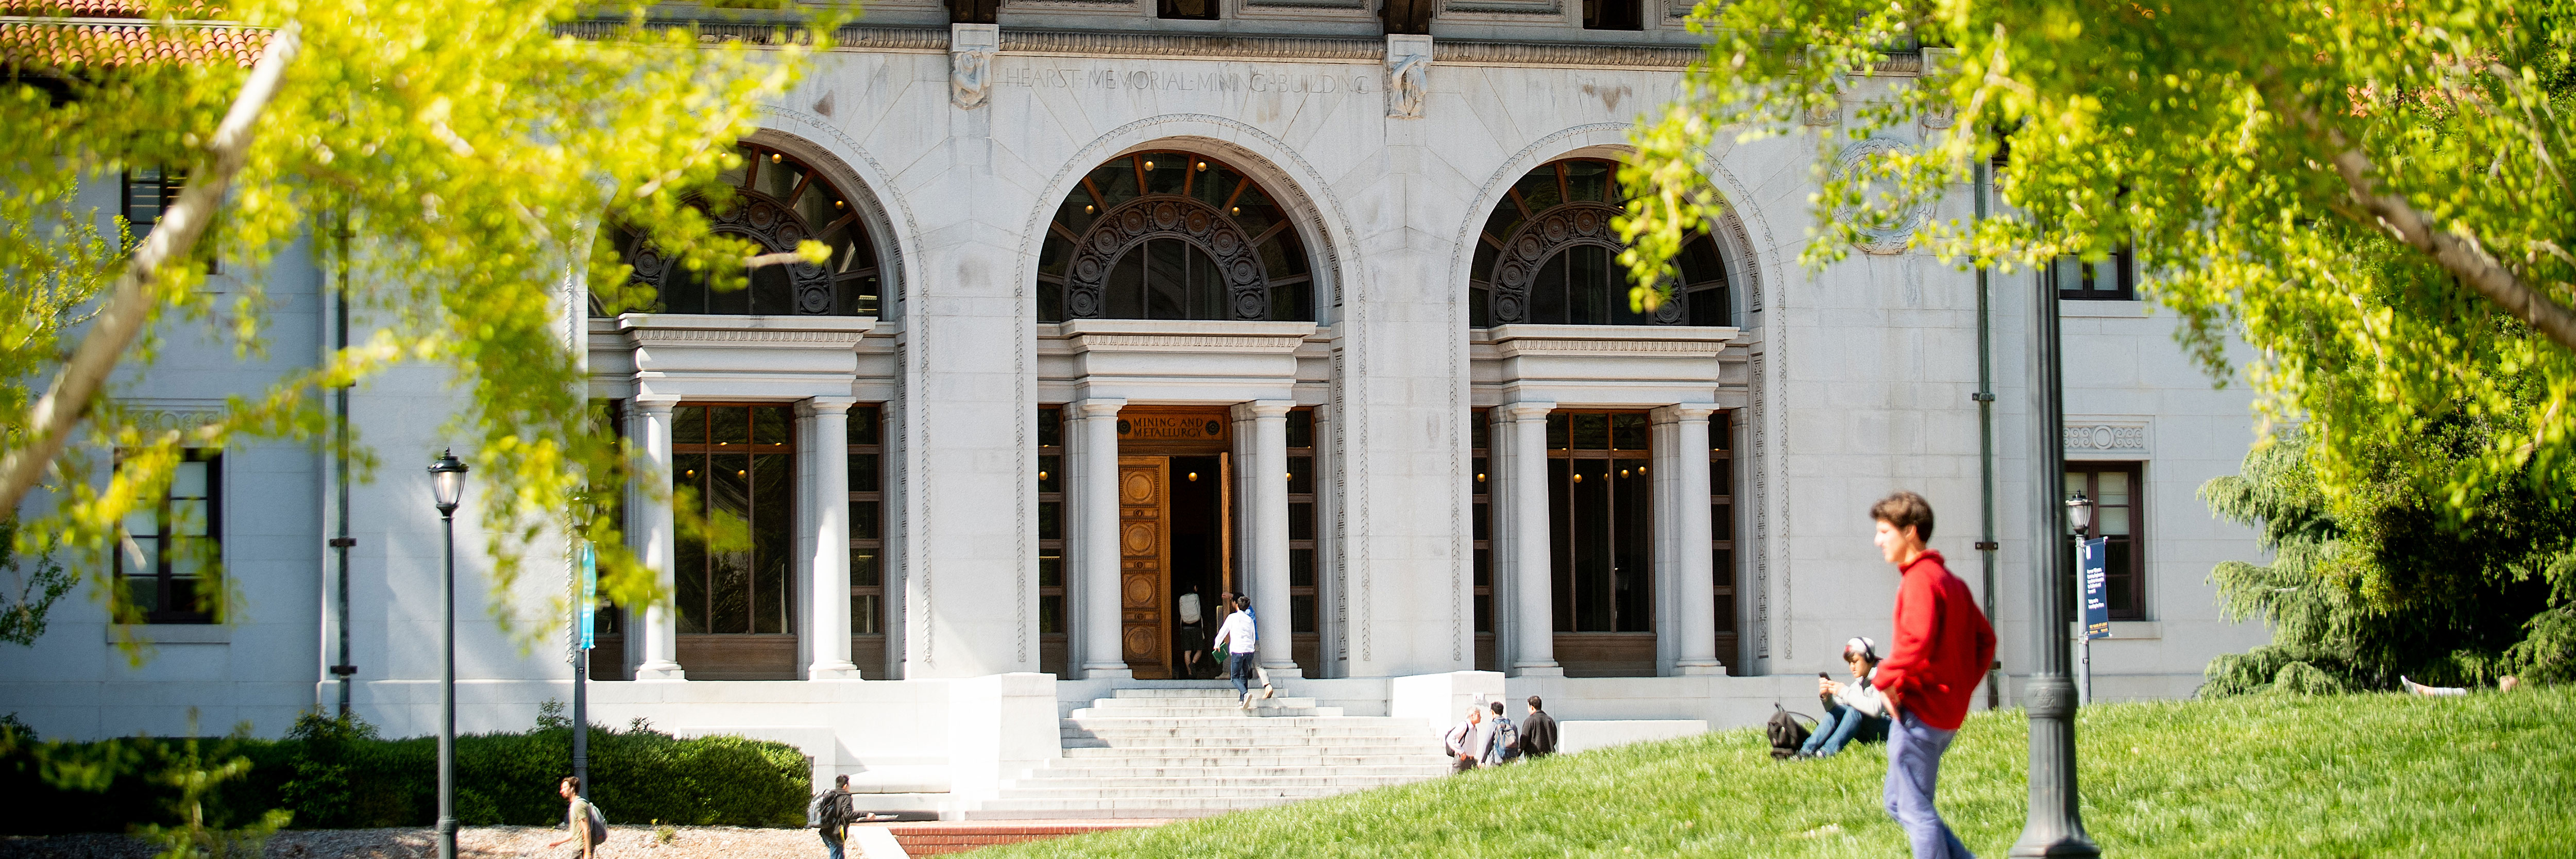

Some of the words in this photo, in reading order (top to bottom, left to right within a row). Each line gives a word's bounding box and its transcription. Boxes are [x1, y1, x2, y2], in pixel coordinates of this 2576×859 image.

[1006, 68, 1081, 88] HEARST
[1088, 69, 1193, 91] MEMORIAL
[1197, 71, 1267, 93] MINING
[1278, 73, 1370, 95] BUILDING
[1133, 417, 1176, 427] MINING
[1180, 418, 1204, 427] AND
[1133, 427, 1204, 437] METALLURGY
